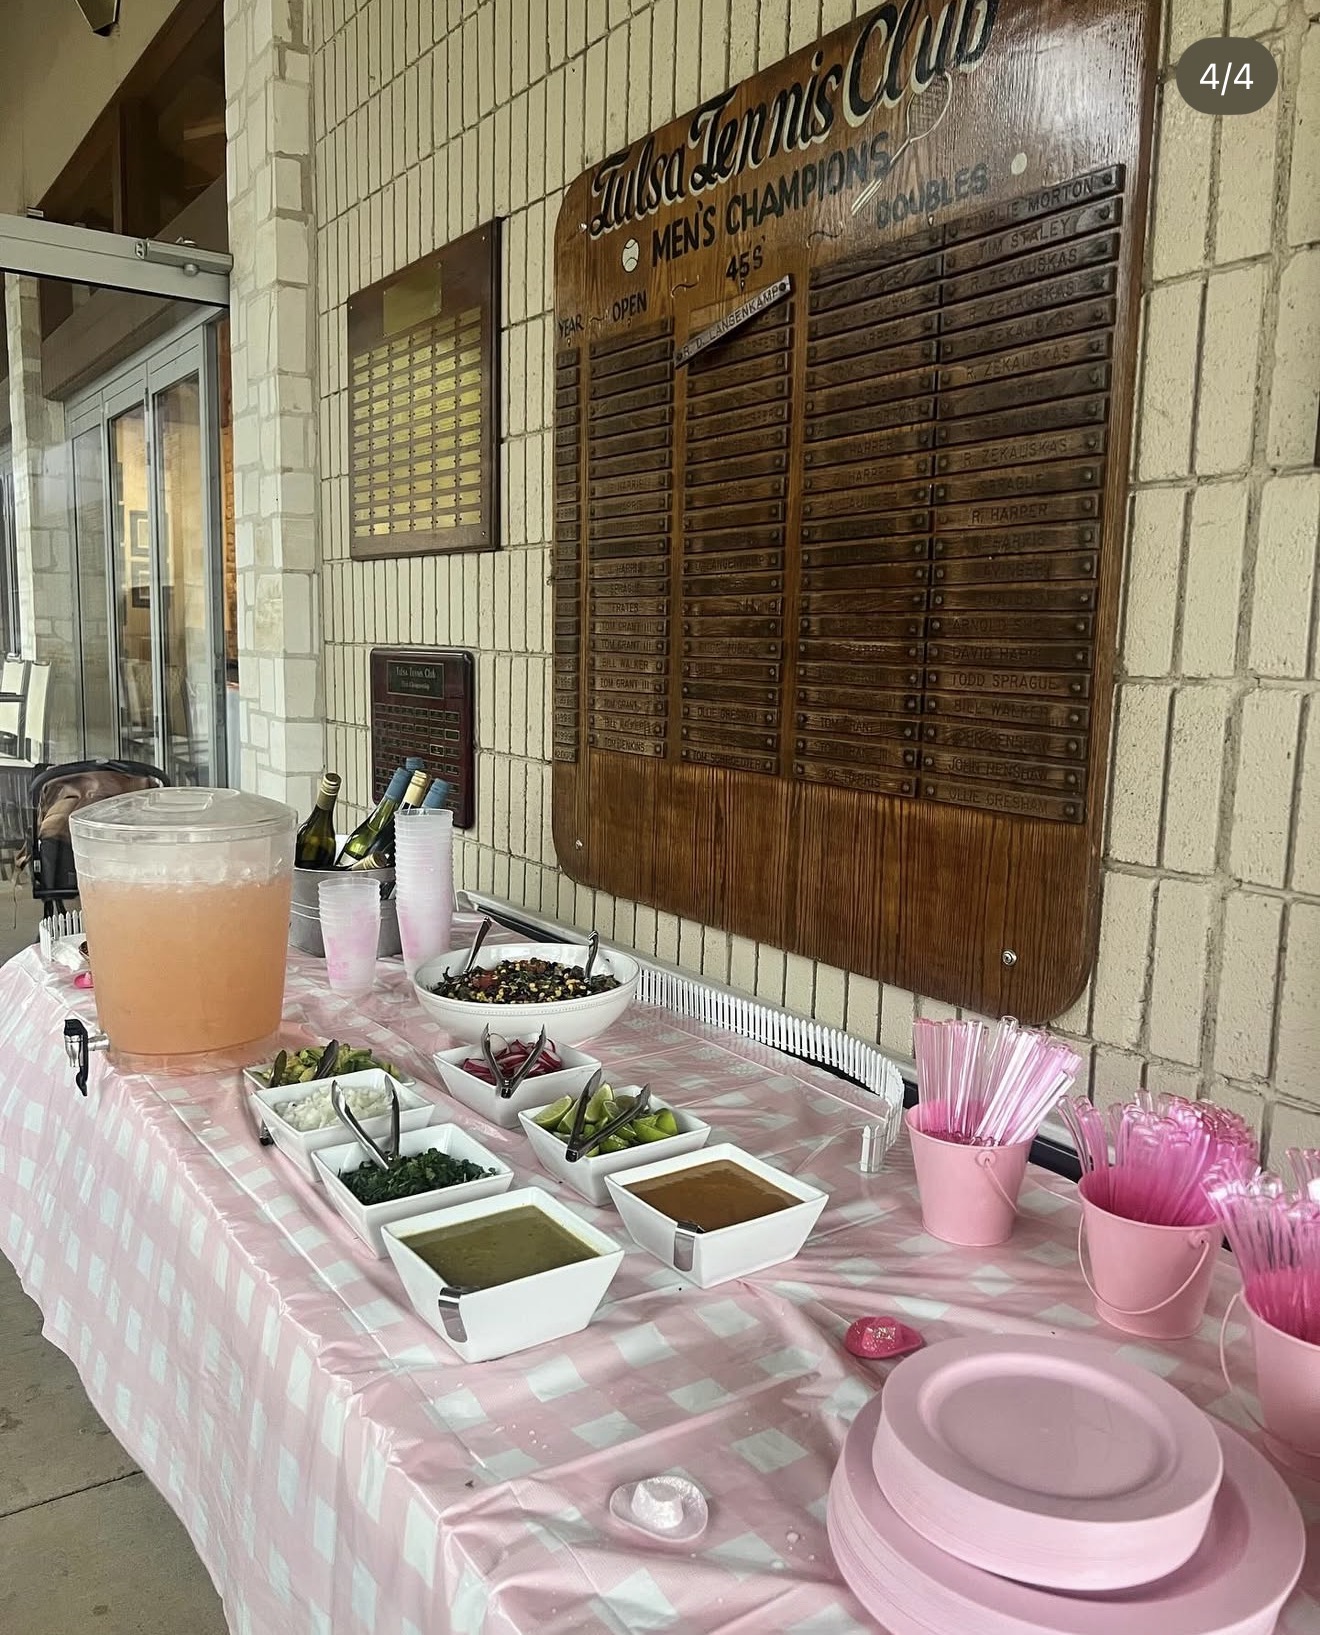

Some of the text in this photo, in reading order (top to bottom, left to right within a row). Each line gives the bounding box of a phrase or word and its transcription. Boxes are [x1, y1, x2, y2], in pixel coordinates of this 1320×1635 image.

[589, 0, 1000, 241] Tulsa Tennis Club
[651, 131, 892, 268] MEN'S CHAMPIONS
[876, 162, 988, 230] DOUBLES
[1028, 177, 1094, 213] MORTON
[1010, 215, 1071, 249] STALEY
[612, 288, 648, 323] OPEN
[558, 313, 585, 338] YEAR
[981, 438, 1068, 464] ZEKAUSKAS
[990, 503, 1049, 521] HARPER
[600, 658, 649, 670] BILL WALKER
[600, 678, 614, 689] TOM
[616, 679, 639, 690] GRANT
[950, 672, 1060, 691] TODD SPRAGUE
[953, 699, 1049, 720] BILL WALKER
